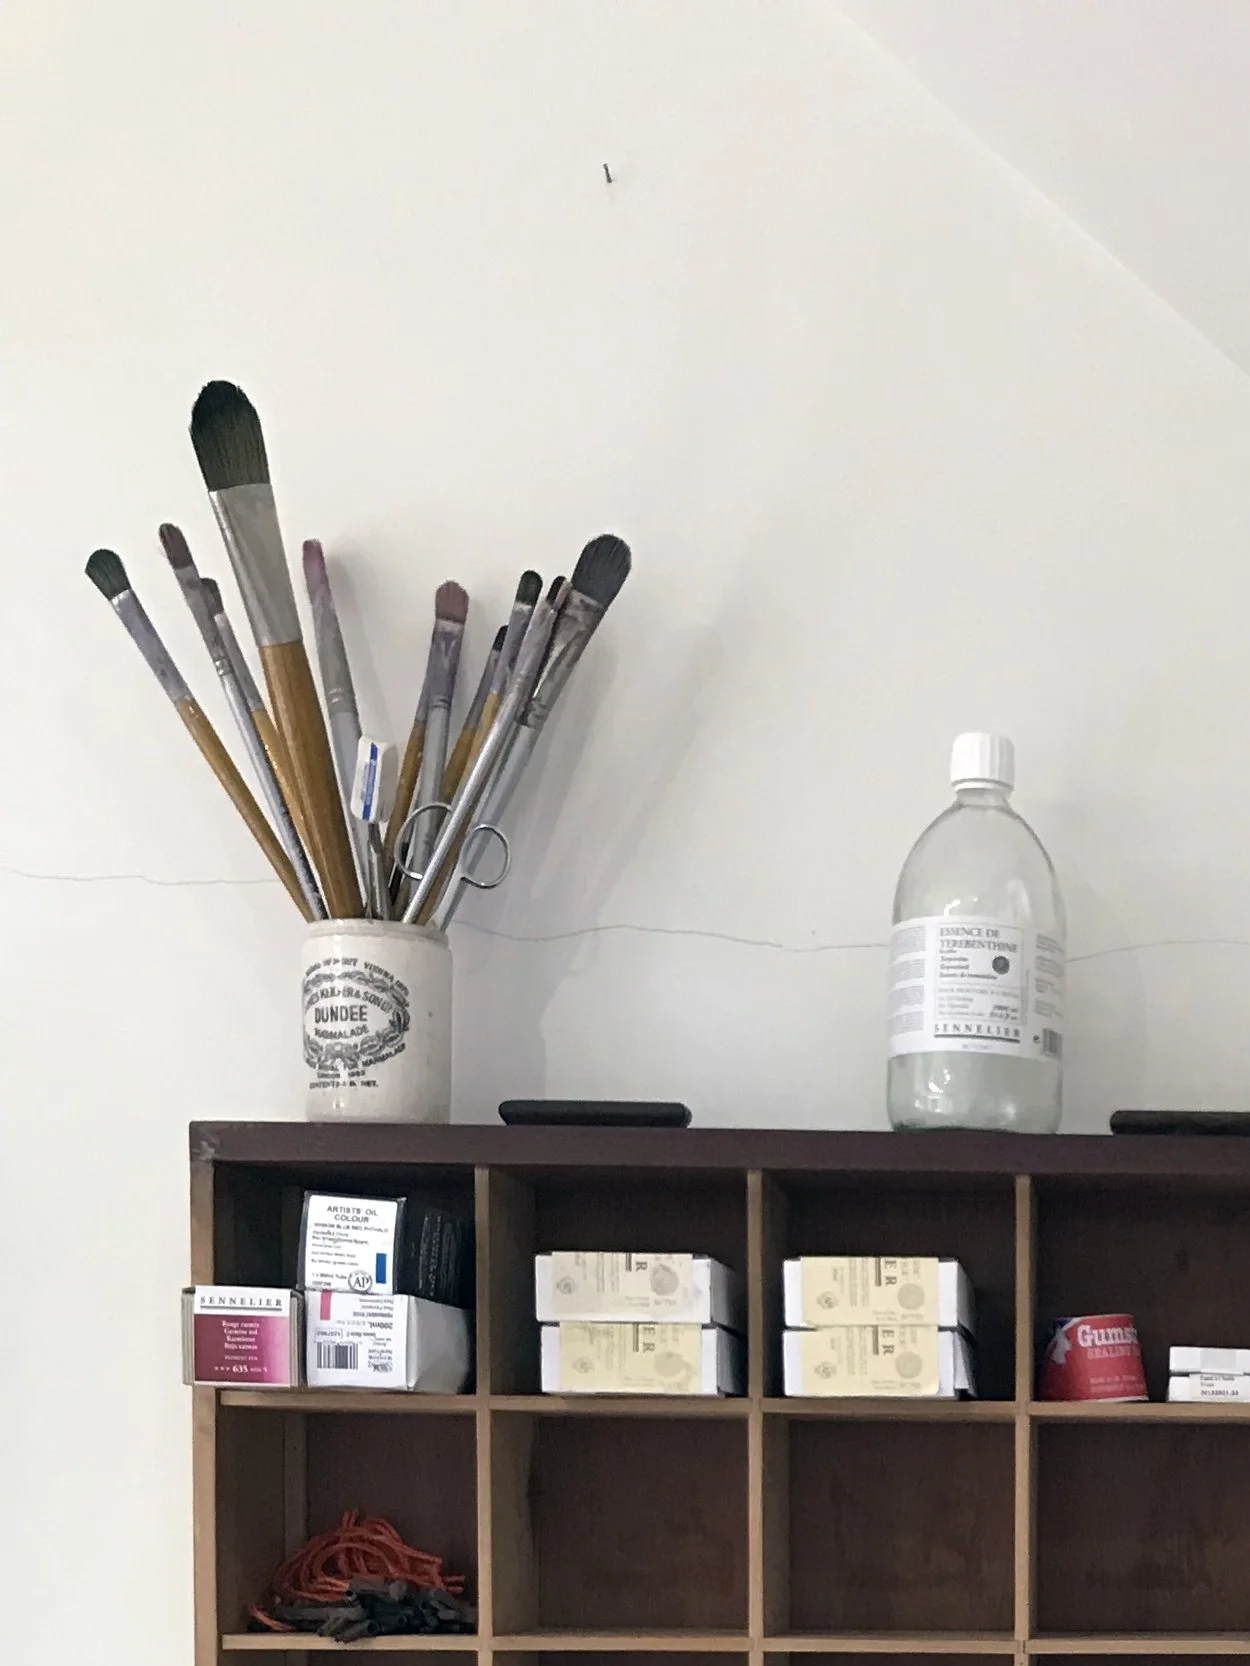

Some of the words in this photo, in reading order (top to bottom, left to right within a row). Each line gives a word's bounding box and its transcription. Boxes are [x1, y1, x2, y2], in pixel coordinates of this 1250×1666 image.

[939, 927, 984, 937] ESSENCE
[986, 929, 1000, 938] DE
[362, 991, 383, 1008] SON
[314, 1004, 368, 1024] DUNDEE
[934, 1024, 1021, 1037] SENNELIER
[334, 1215, 370, 1223] COLOUR
[354, 1277, 370, 1288] AP
[200, 1296, 282, 1306] SENNELIER
[232, 1364, 248, 1373] 635
